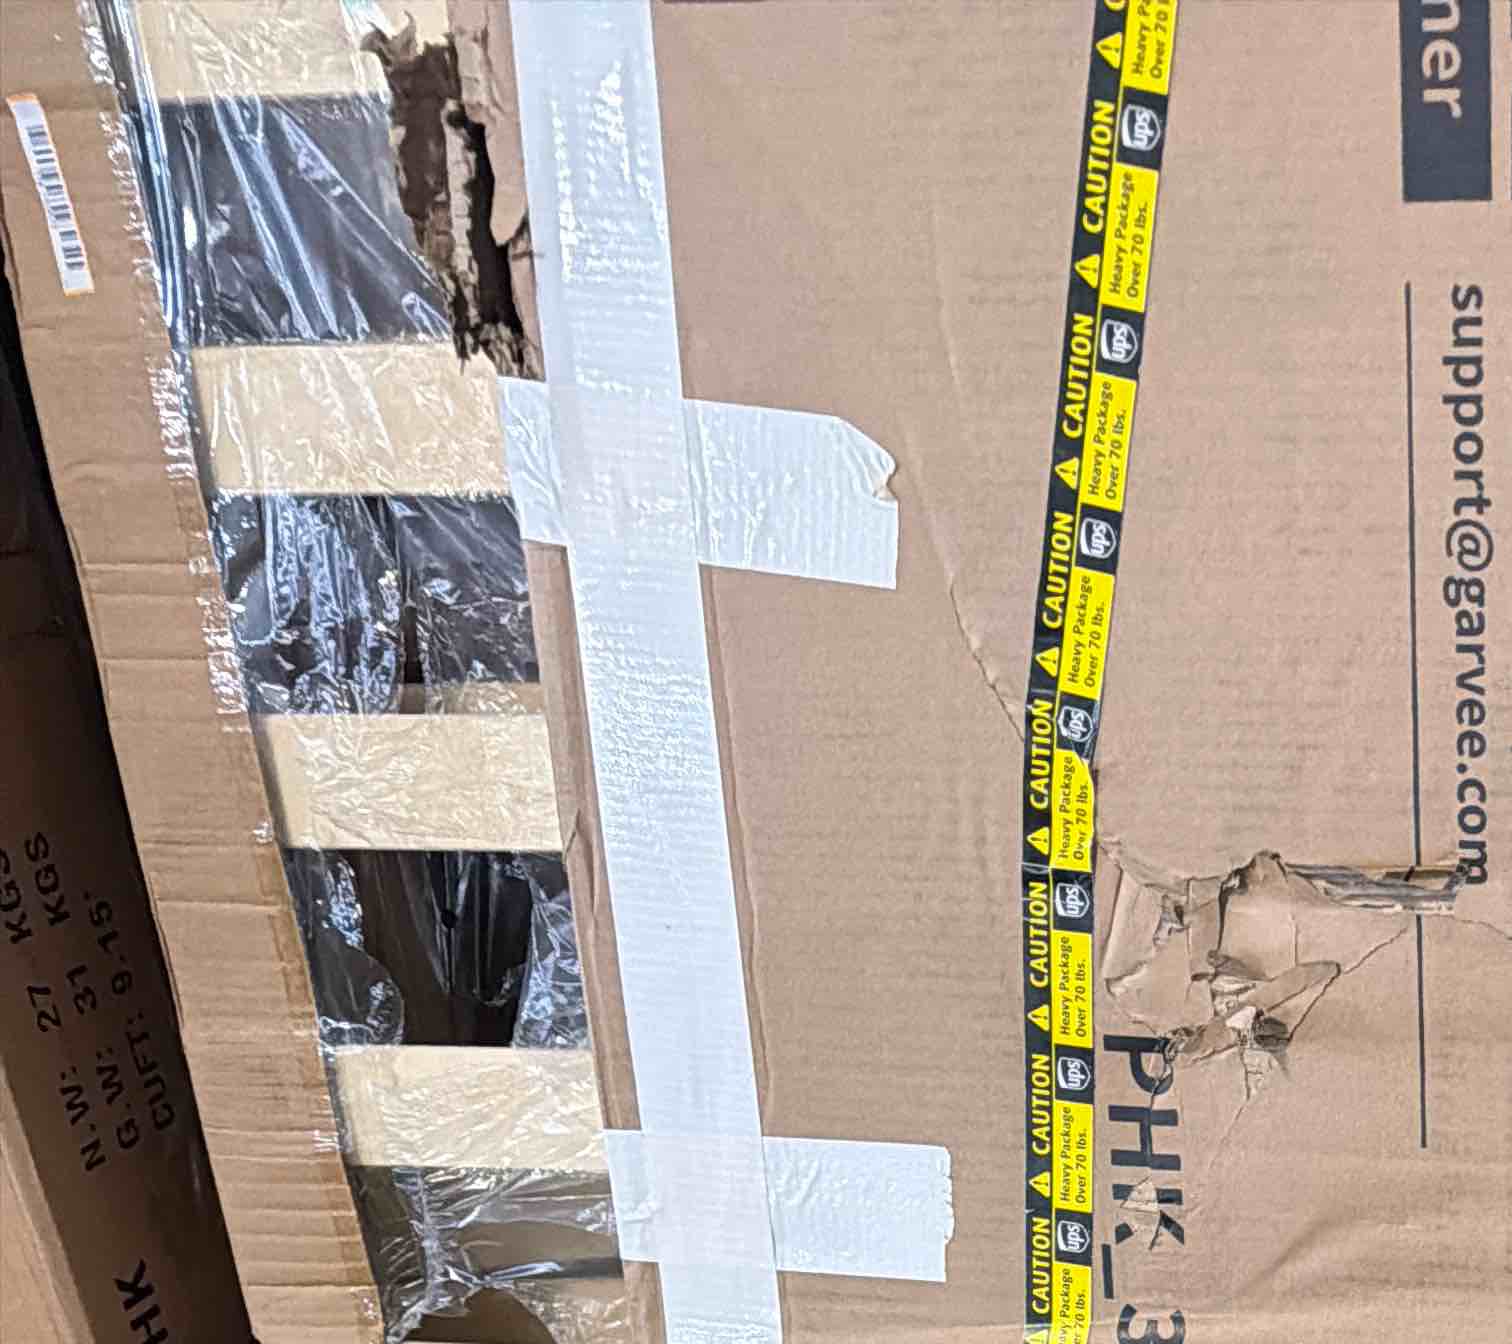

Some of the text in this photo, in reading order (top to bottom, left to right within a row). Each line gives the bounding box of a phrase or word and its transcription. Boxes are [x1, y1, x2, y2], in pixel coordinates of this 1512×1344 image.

[1081, 99, 1115, 234] CAUTION
[1108, 170, 1137, 294] Heavy Package
[1130, 232, 1145, 254] 70
[1126, 260, 1143, 299] Over
[1061, 312, 1095, 439] CAUTION
[1087, 378, 1115, 494] Heavy Package
[1108, 436, 1122, 456] 70
[1104, 462, 1120, 498] Over
[1041, 510, 1075, 630] CAUTION
[1442, 284, 1495, 886] support@garvee.com
[1067, 572, 1094, 682] Heavy Package
[1087, 628, 1102, 647] 70
[1083, 652, 1100, 686] Over
[1030, 698, 1053, 810] CAUTION
[1058, 755, 1075, 858] Heavy Package
[1074, 807, 1086, 824] 70
[1074, 830, 1086, 861] Over
[24, 832, 70, 926] KGS
[1028, 880, 1048, 987] CAUTION
[26, 984, 62, 1033] 27
[65, 965, 98, 1014] 31
[1059, 934, 1073, 1035] Heavy Package
[1074, 984, 1087, 1001] 70
[1075, 1007, 1088, 1038] Over
[1032, 1053, 1050, 1155] CAUTION
[1060, 1105, 1074, 1199] Heavy Package
[1075, 1151, 1087, 1168] 70
[1076, 1173, 1088, 1202] Over
[1028, 1216, 1054, 1315] CAUTION
[1057, 1266, 1074, 1318] Package
[1071, 1313, 1083, 1329] 70
